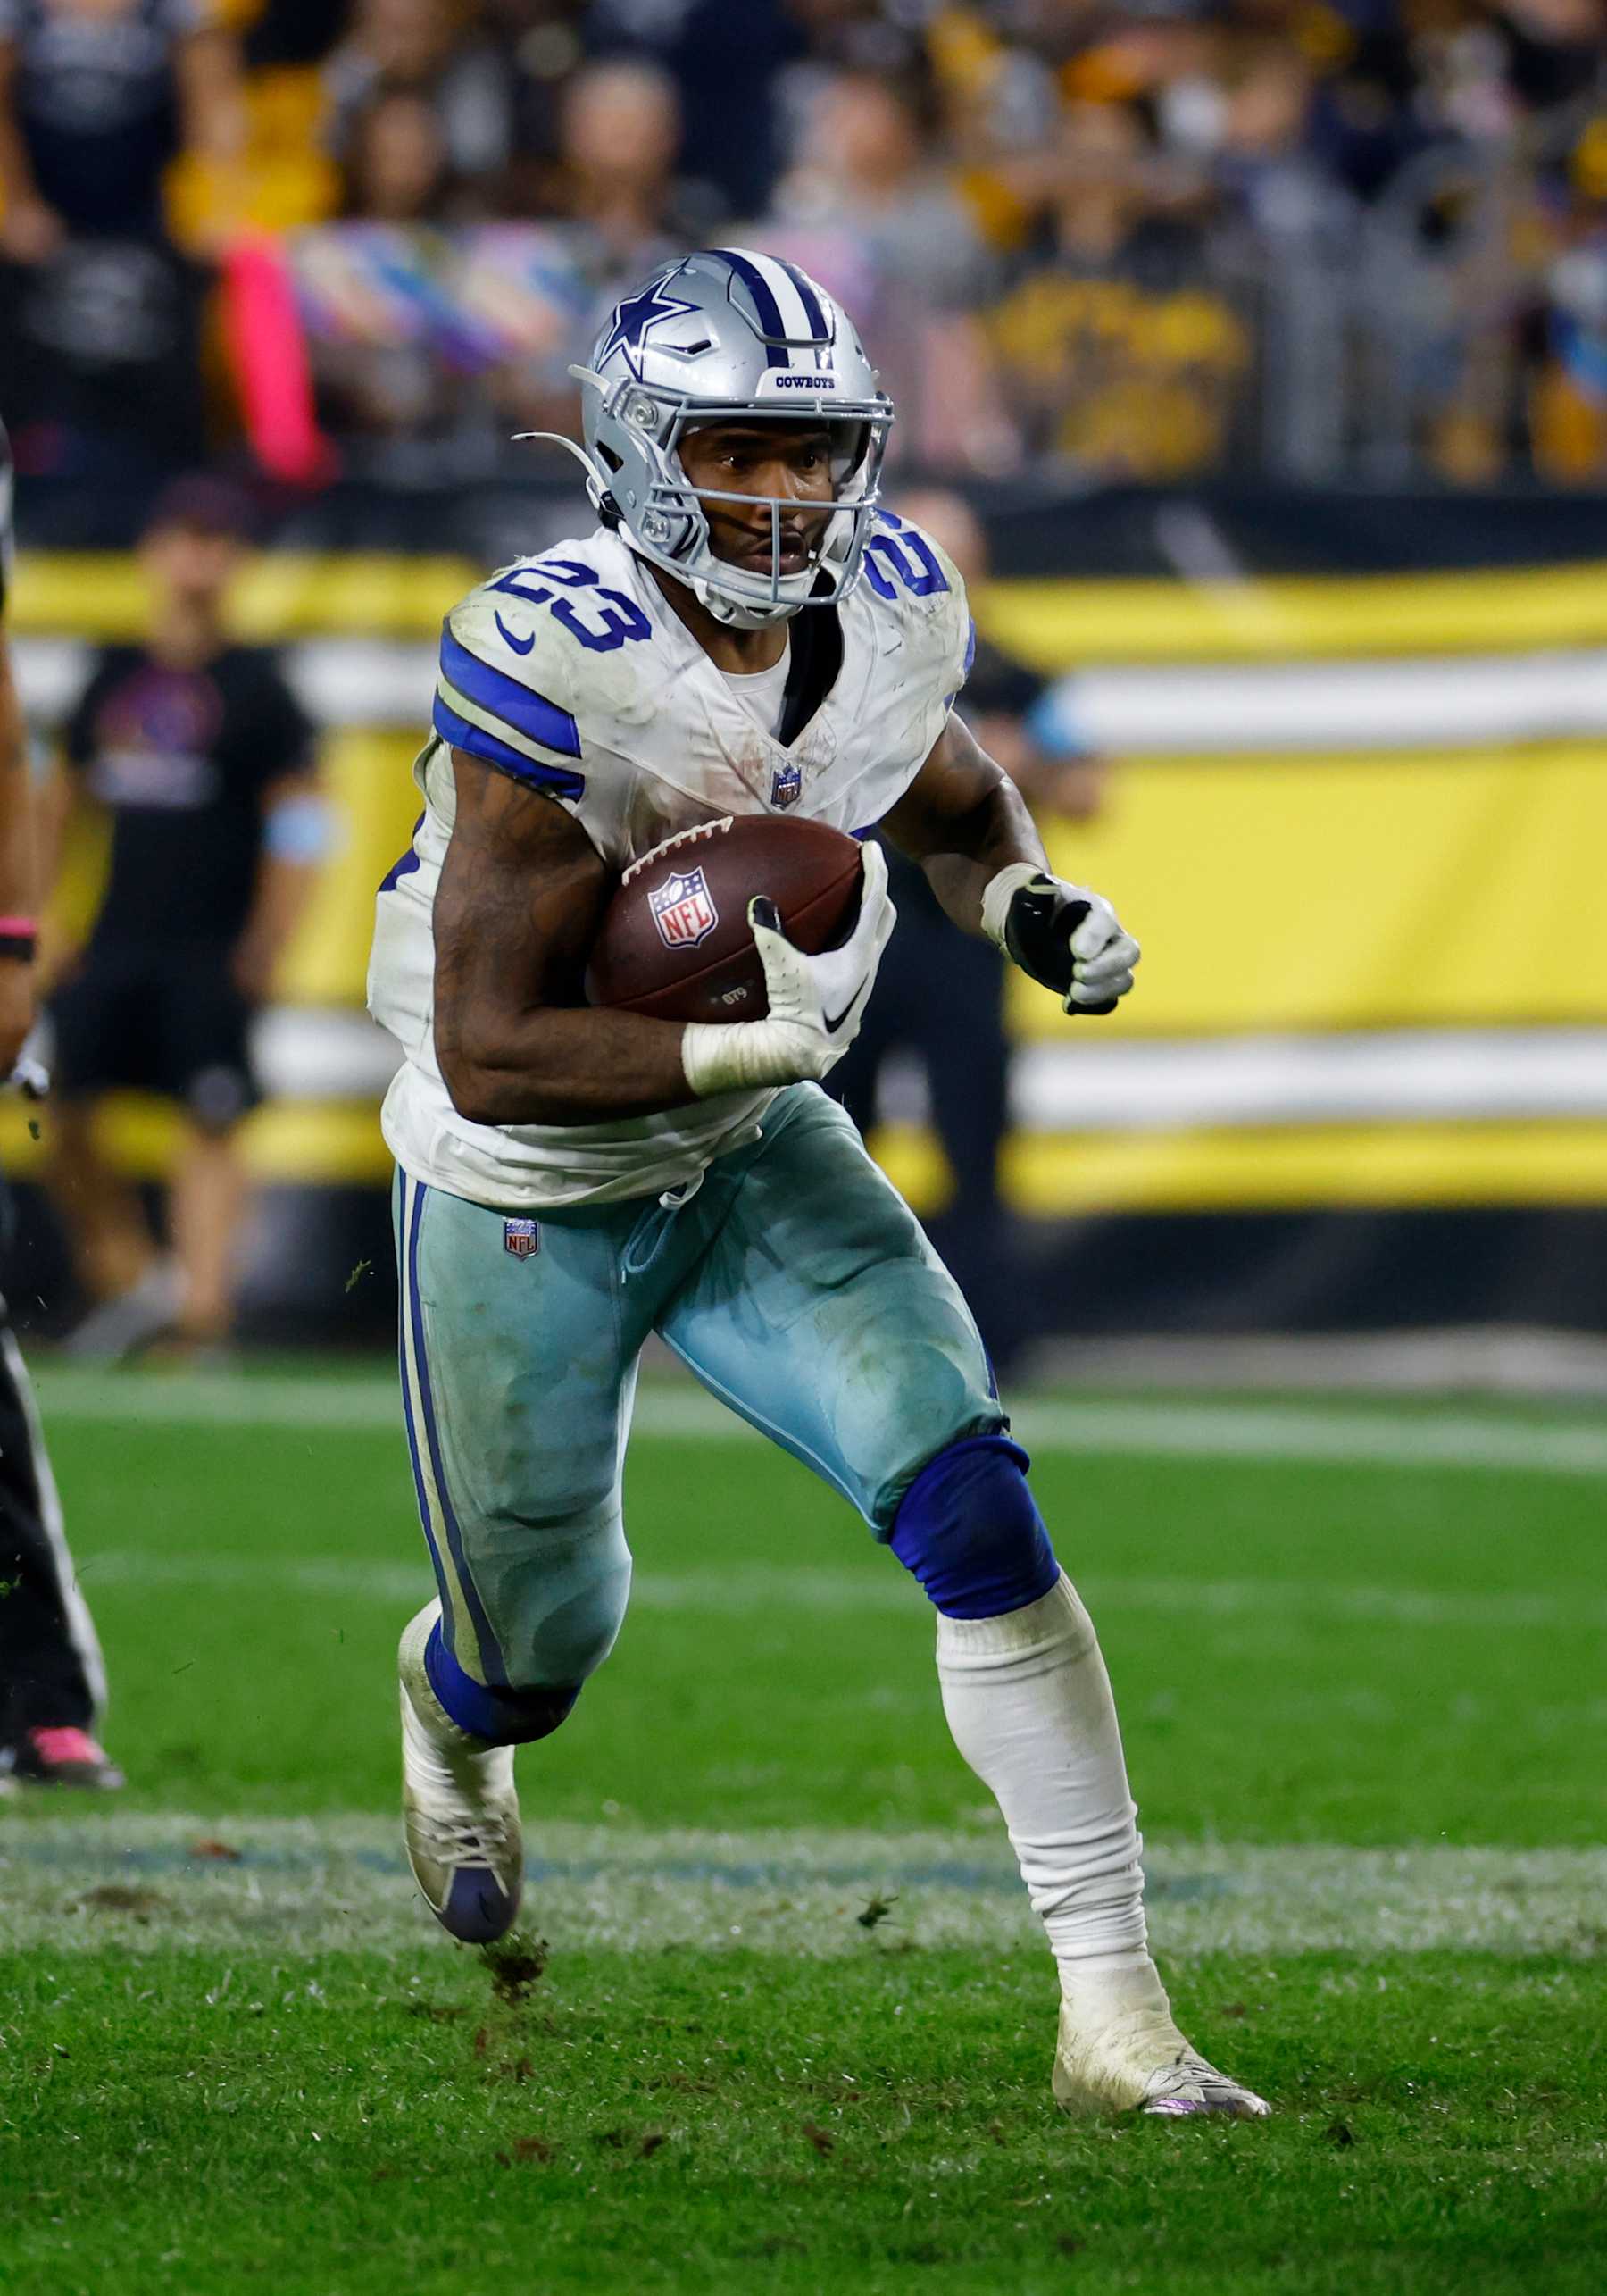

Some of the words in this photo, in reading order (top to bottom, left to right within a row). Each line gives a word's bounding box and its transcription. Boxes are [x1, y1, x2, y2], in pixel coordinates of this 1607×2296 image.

[776, 376, 835, 389] COWBOYS
[484, 560, 652, 653] 23
[662, 898, 711, 941] NFL
[509, 1235, 535, 1252] NFL
